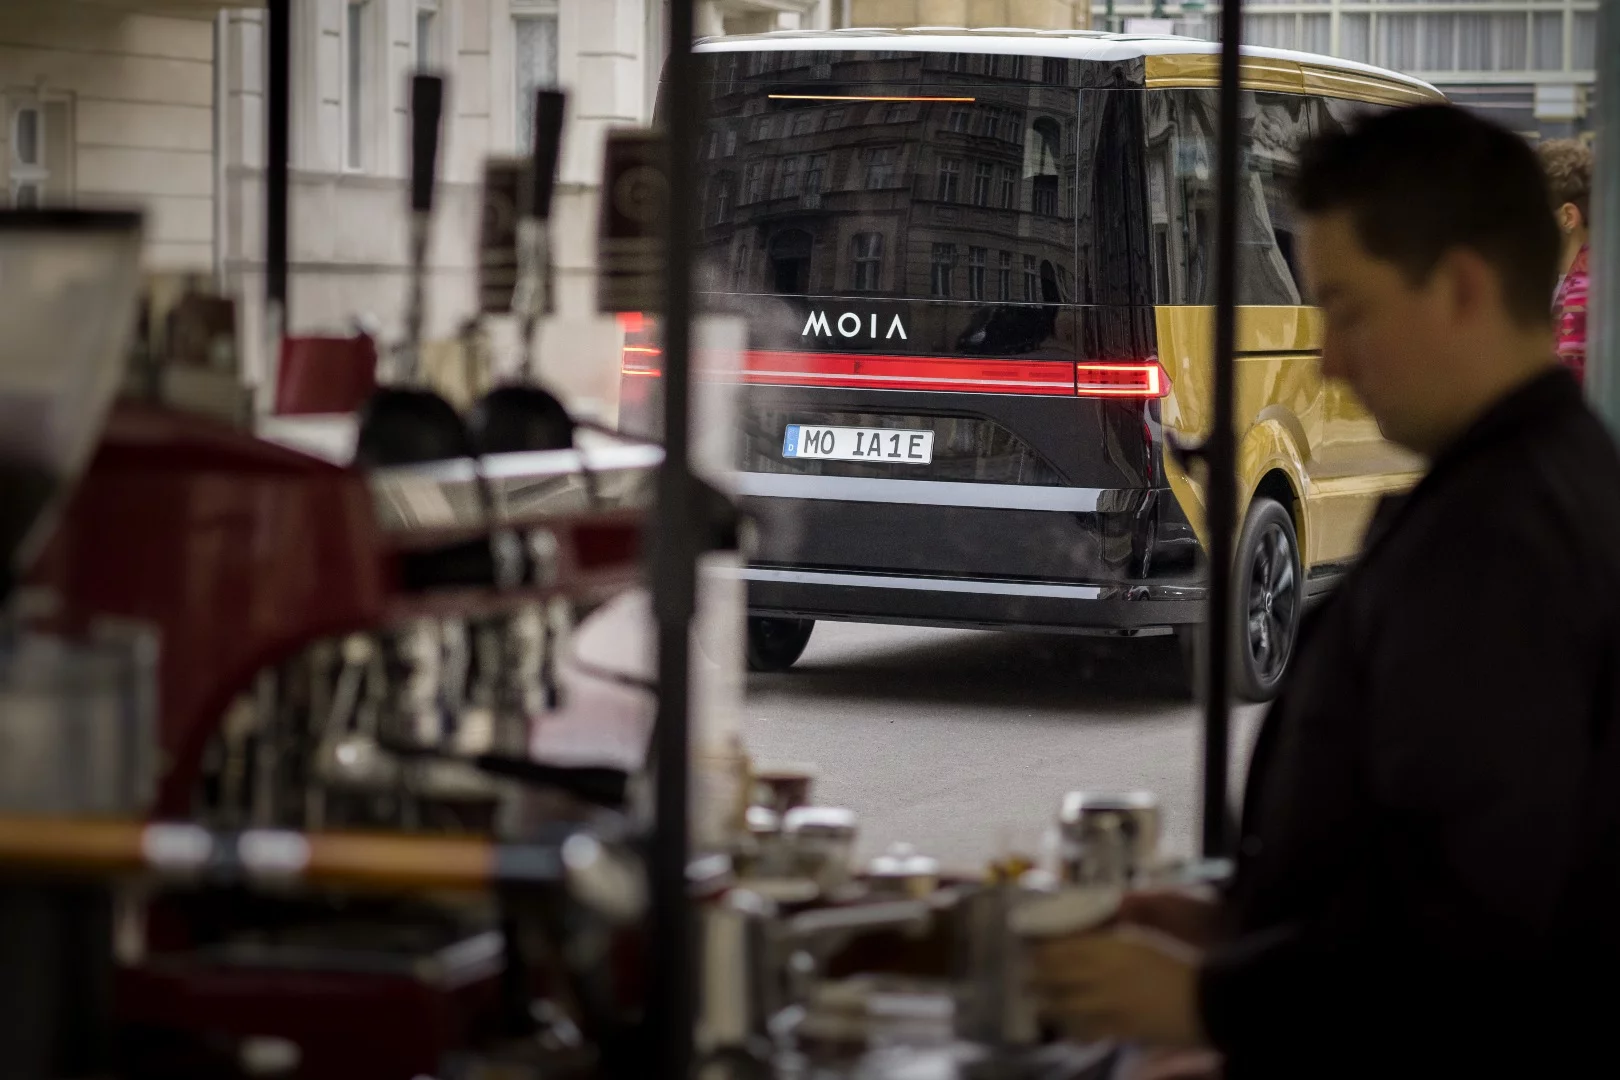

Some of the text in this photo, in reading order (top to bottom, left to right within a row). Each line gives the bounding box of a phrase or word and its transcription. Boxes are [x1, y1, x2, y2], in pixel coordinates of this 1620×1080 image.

[802, 311, 907, 339] MOIA
[788, 443, 794, 452] D
[803, 430, 924, 458] MO IA1E
